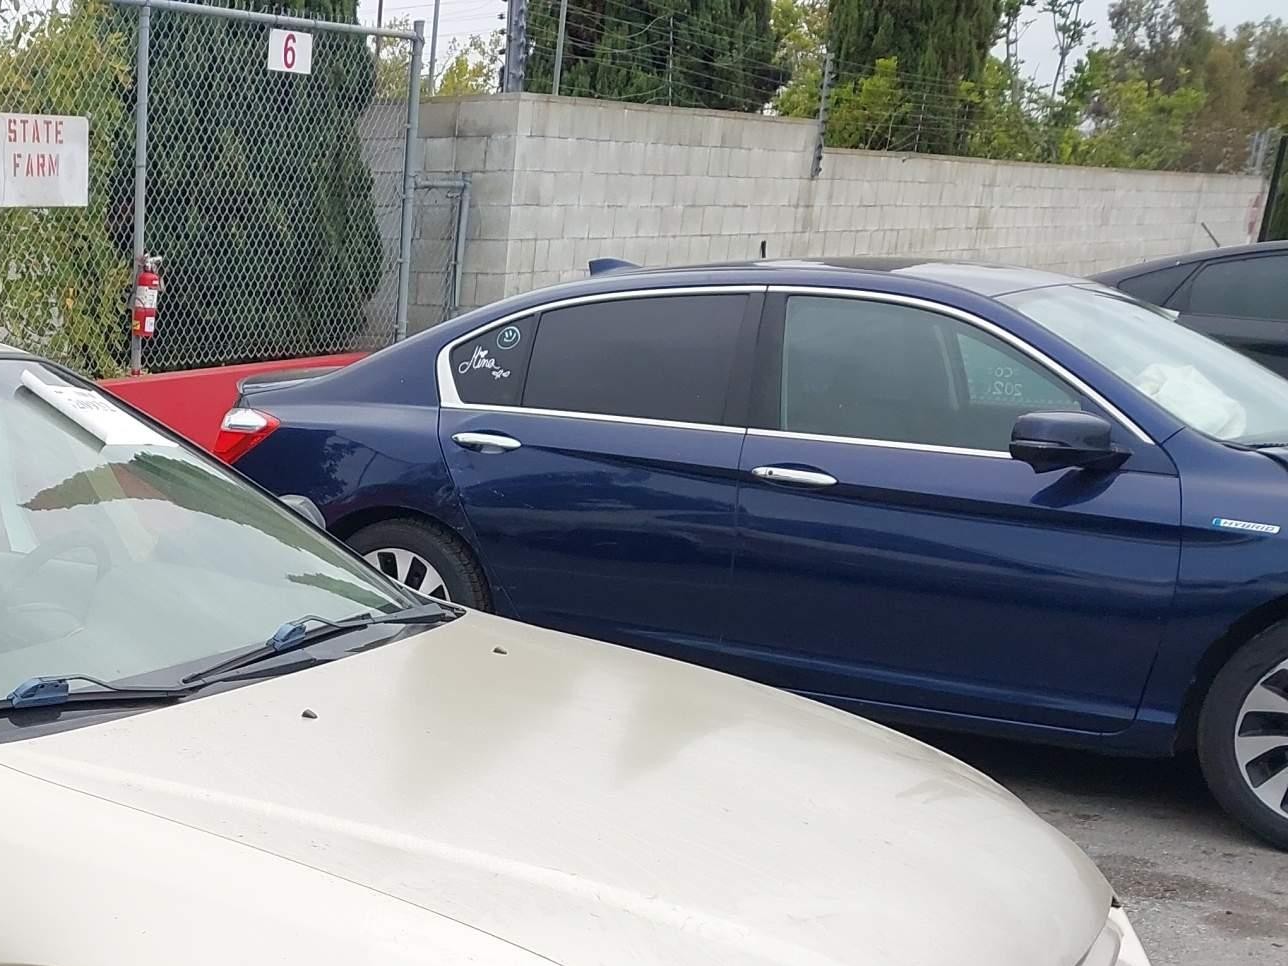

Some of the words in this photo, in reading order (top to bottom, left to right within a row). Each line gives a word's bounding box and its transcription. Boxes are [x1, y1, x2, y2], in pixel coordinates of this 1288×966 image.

[283, 33, 297, 69] 6
[7, 118, 64, 144] STATE
[13, 152, 60, 177] FARM
